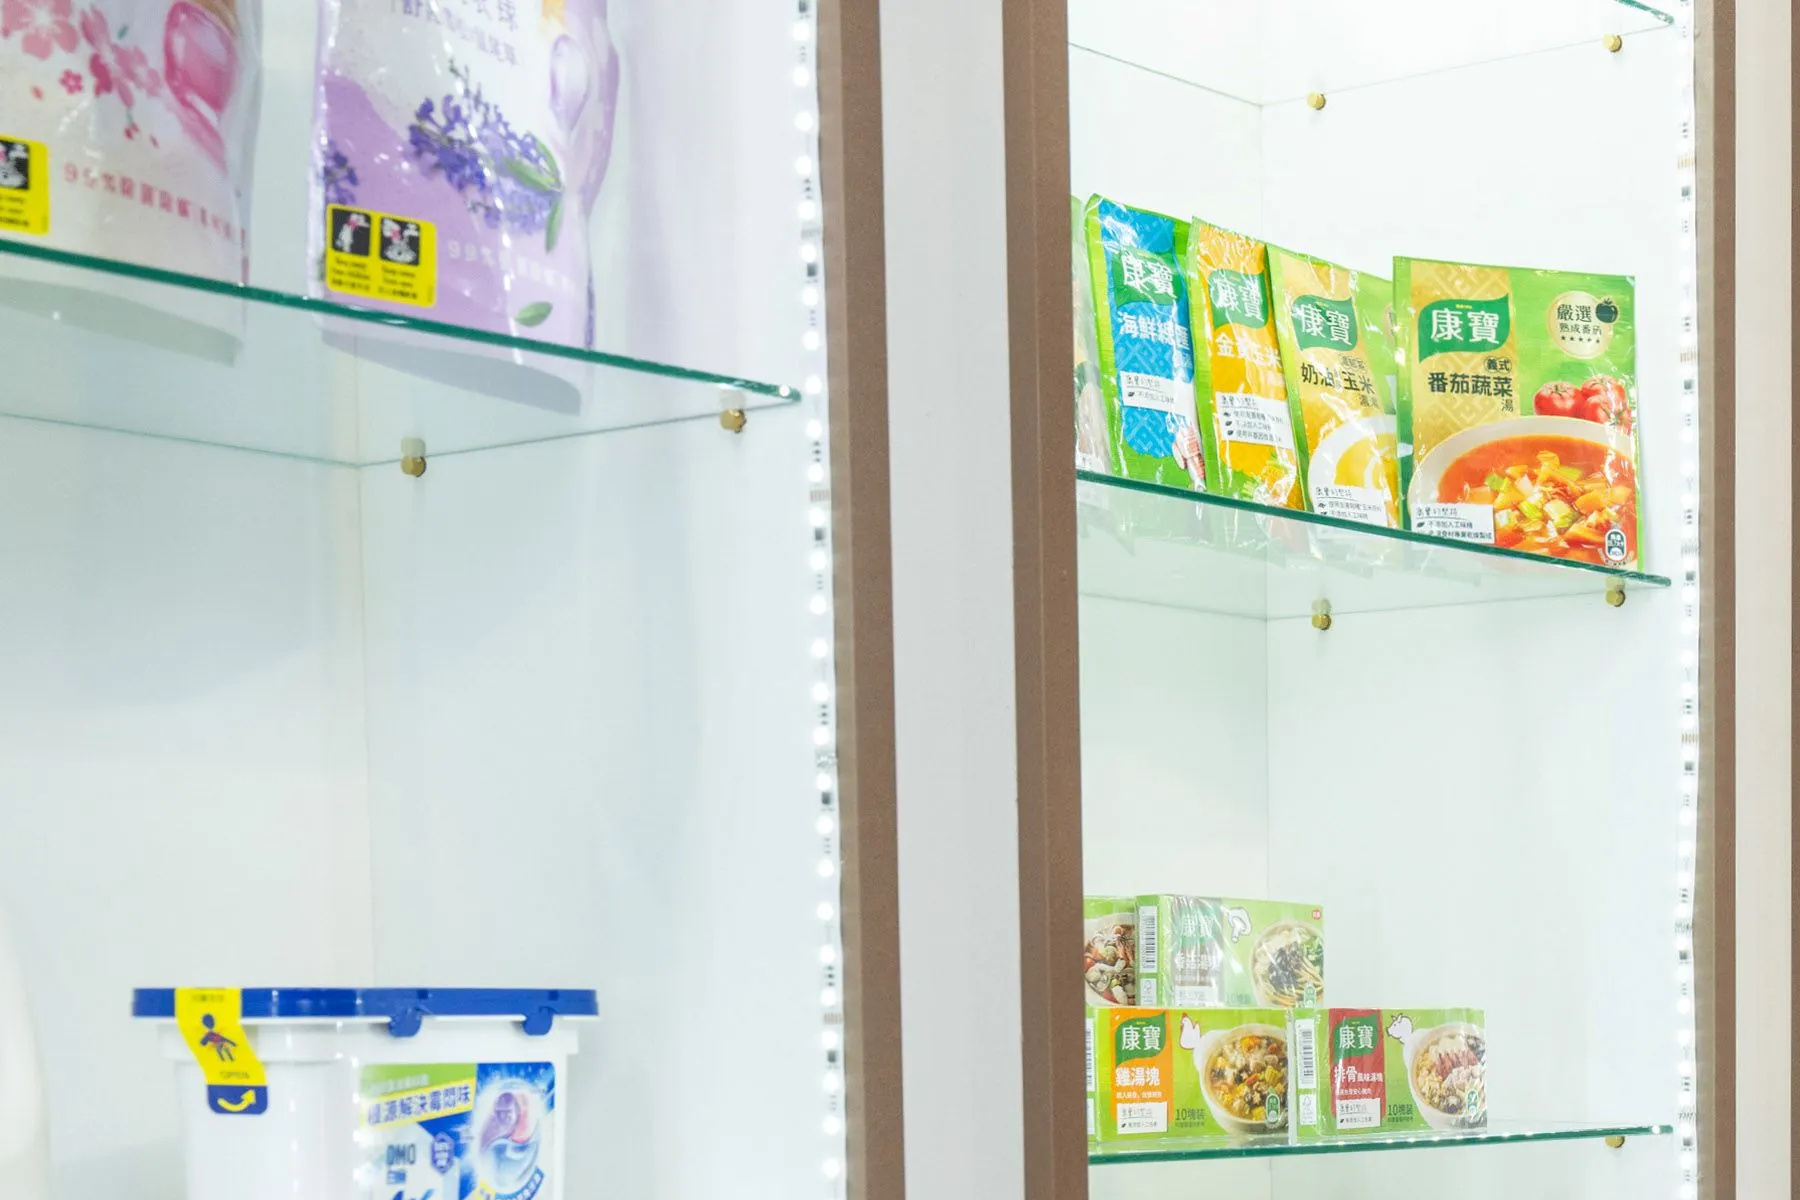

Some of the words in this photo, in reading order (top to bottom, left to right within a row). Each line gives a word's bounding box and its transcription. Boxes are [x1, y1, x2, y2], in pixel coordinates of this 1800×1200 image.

[1120, 250, 1178, 300] 康寶
[1213, 276, 1265, 323] 康寶
[1300, 303, 1353, 346] 康寶
[1557, 303, 1592, 323] 嚴選
[1431, 308, 1500, 345] 康寶
[1300, 362, 1376, 395] 奶油玉米
[1486, 358, 1511, 373] 義式
[1428, 372, 1513, 398] 番茄蔬菜
[1501, 398, 1514, 413] 湯
[1122, 1025, 1161, 1051] 康寶
[1338, 1025, 1374, 1050] 康寶
[1115, 1066, 1161, 1087] 雞湯塊
[387, 1143, 416, 1166] OMO
